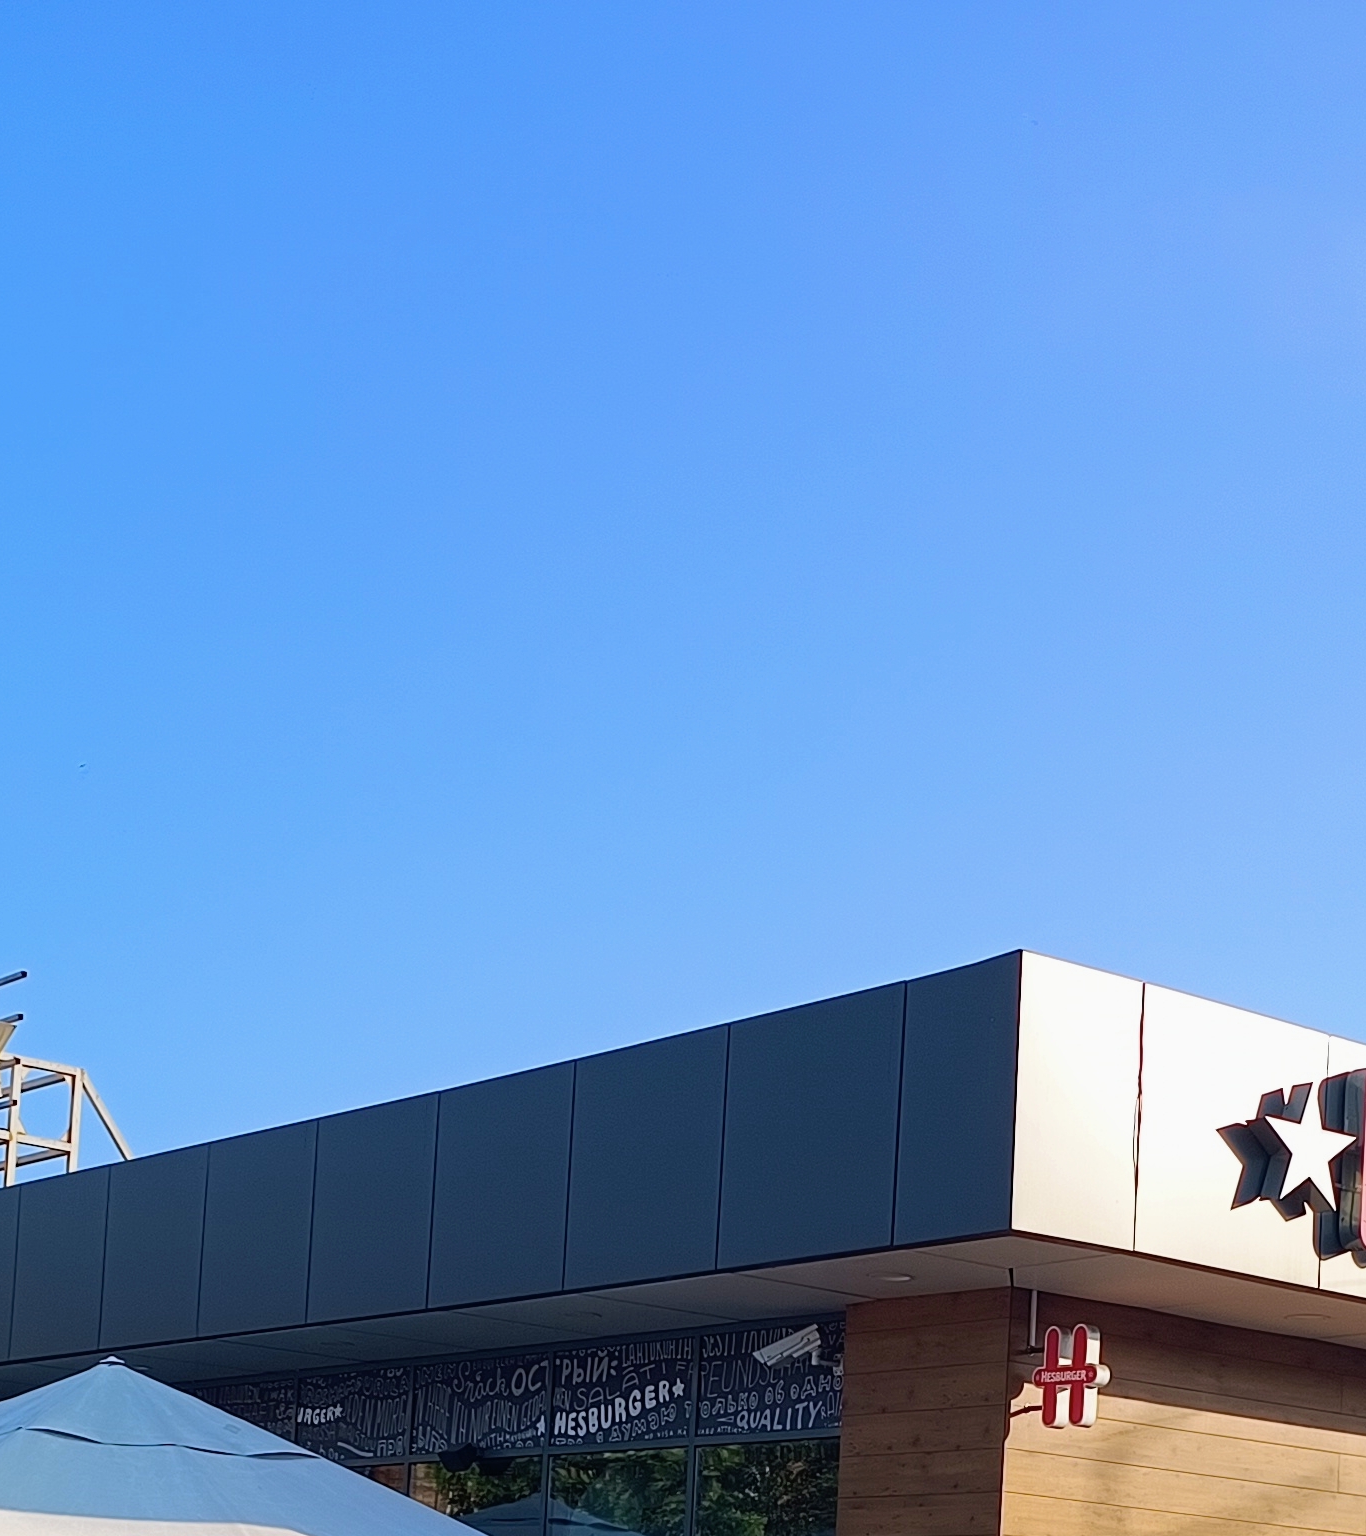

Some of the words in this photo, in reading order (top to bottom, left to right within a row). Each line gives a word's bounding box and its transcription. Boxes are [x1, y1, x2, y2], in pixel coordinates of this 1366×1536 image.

[1040, 1370, 1087, 1383] HESBURGER
[554, 1380, 670, 1437] HESBURGER
[737, 1401, 822, 1432] QUALITY
